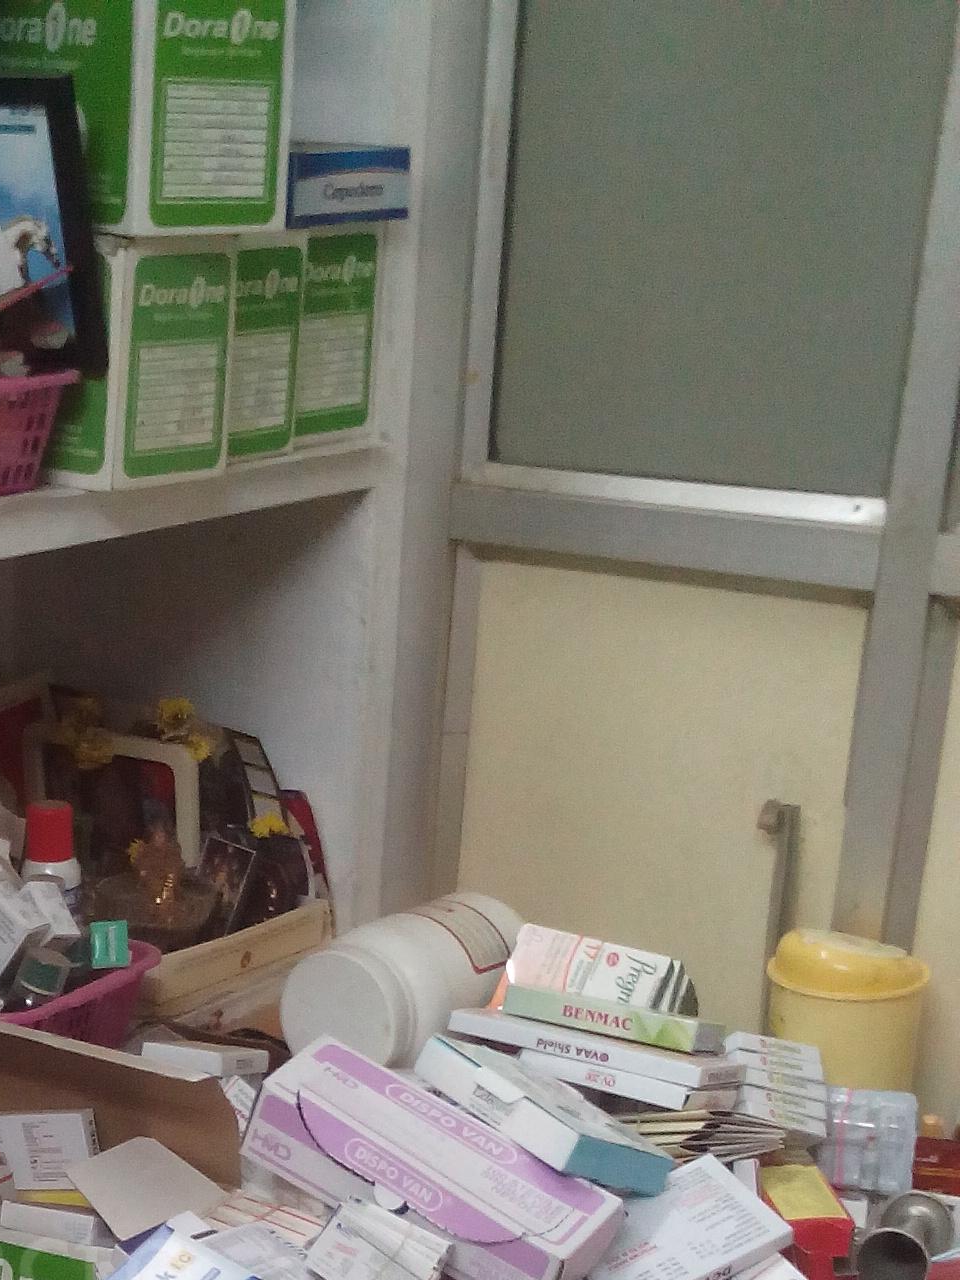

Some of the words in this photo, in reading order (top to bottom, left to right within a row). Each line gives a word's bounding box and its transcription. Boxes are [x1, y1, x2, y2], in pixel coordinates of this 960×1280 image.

[561, 1003, 634, 1032] BENMAC
[536, 1037, 572, 1057] Shield
[396, 1089, 457, 1130] DISPO
[460, 1124, 505, 1155] VAN
[354, 1146, 398, 1179] DISPO
[401, 1169, 433, 1204] VAN
